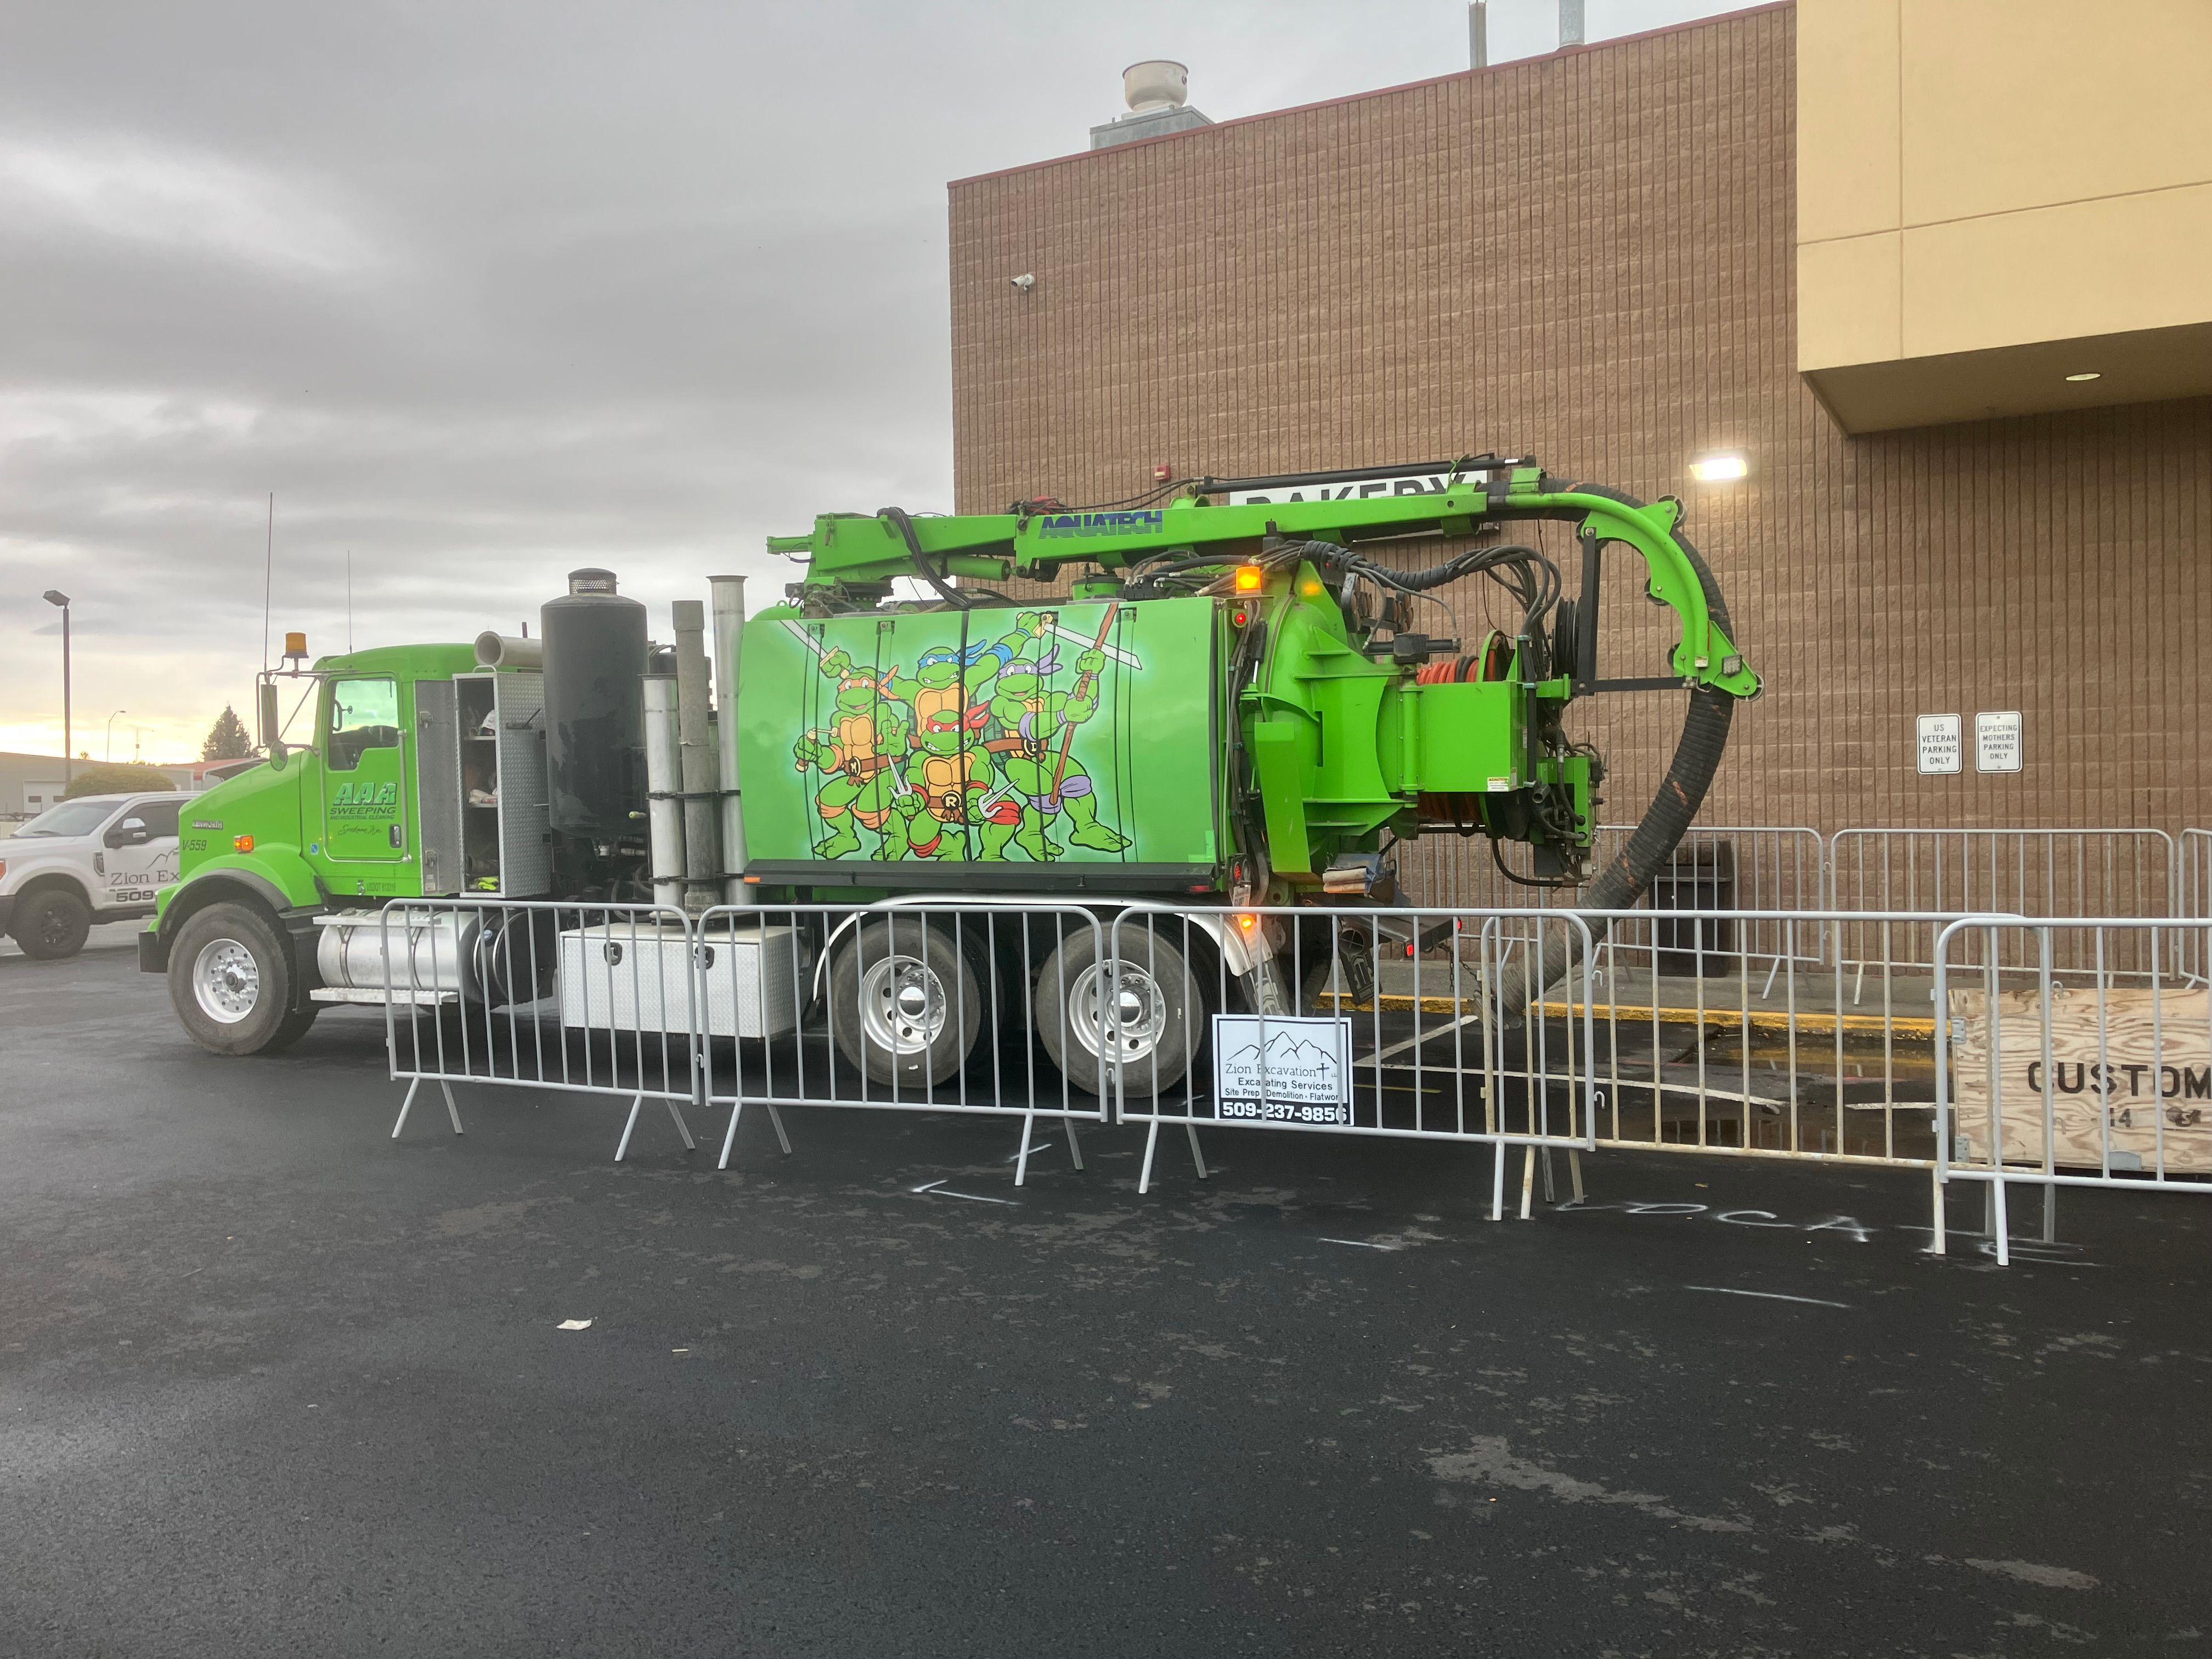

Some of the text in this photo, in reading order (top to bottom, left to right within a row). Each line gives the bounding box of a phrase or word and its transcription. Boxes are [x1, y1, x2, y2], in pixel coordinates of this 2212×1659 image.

[1039, 511, 1163, 539] AQUATECH
[1980, 724, 2018, 732] EXPECTING
[1922, 735, 1957, 743] VETERAN
[1922, 746, 1957, 754] PARKING
[850, 761, 857, 774] M
[332, 782, 398, 806] AAA
[945, 797, 956, 807] R
[183, 839, 207, 851] V-559
[111, 872, 150, 885] Zion
[1225, 1063, 1251, 1074] Zion
[1257, 1064, 1317, 1077] Excavation
[1238, 1077, 1333, 1090] Excaating Services
[2028, 1062, 2212, 1099] CUSTOM
[1225, 1088, 1338, 1101] Site Prep Demolition Flatwor
